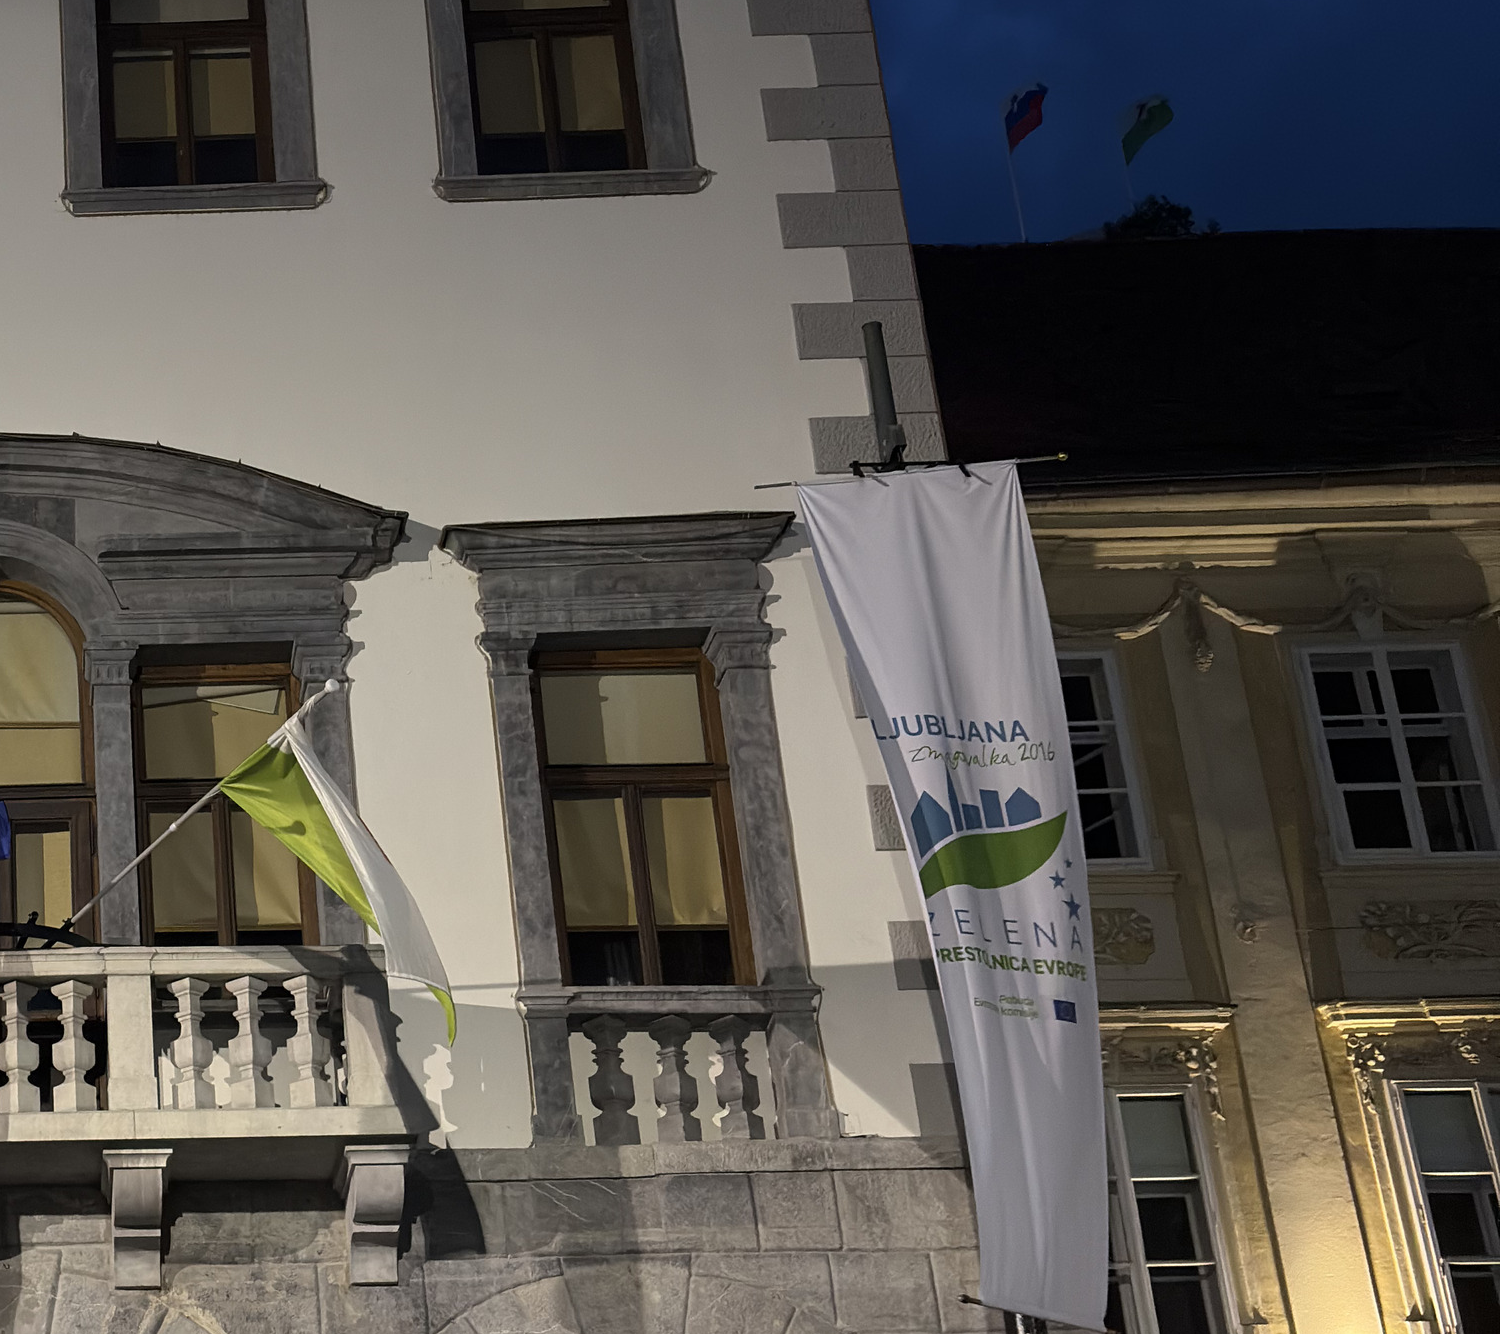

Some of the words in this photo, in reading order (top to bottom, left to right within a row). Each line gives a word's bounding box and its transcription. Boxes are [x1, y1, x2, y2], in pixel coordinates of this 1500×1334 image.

[871, 714, 1030, 744] LJUBLJANA
[1018, 741, 1056, 762] 2016
[1033, 959, 1088, 982] EVROPE
